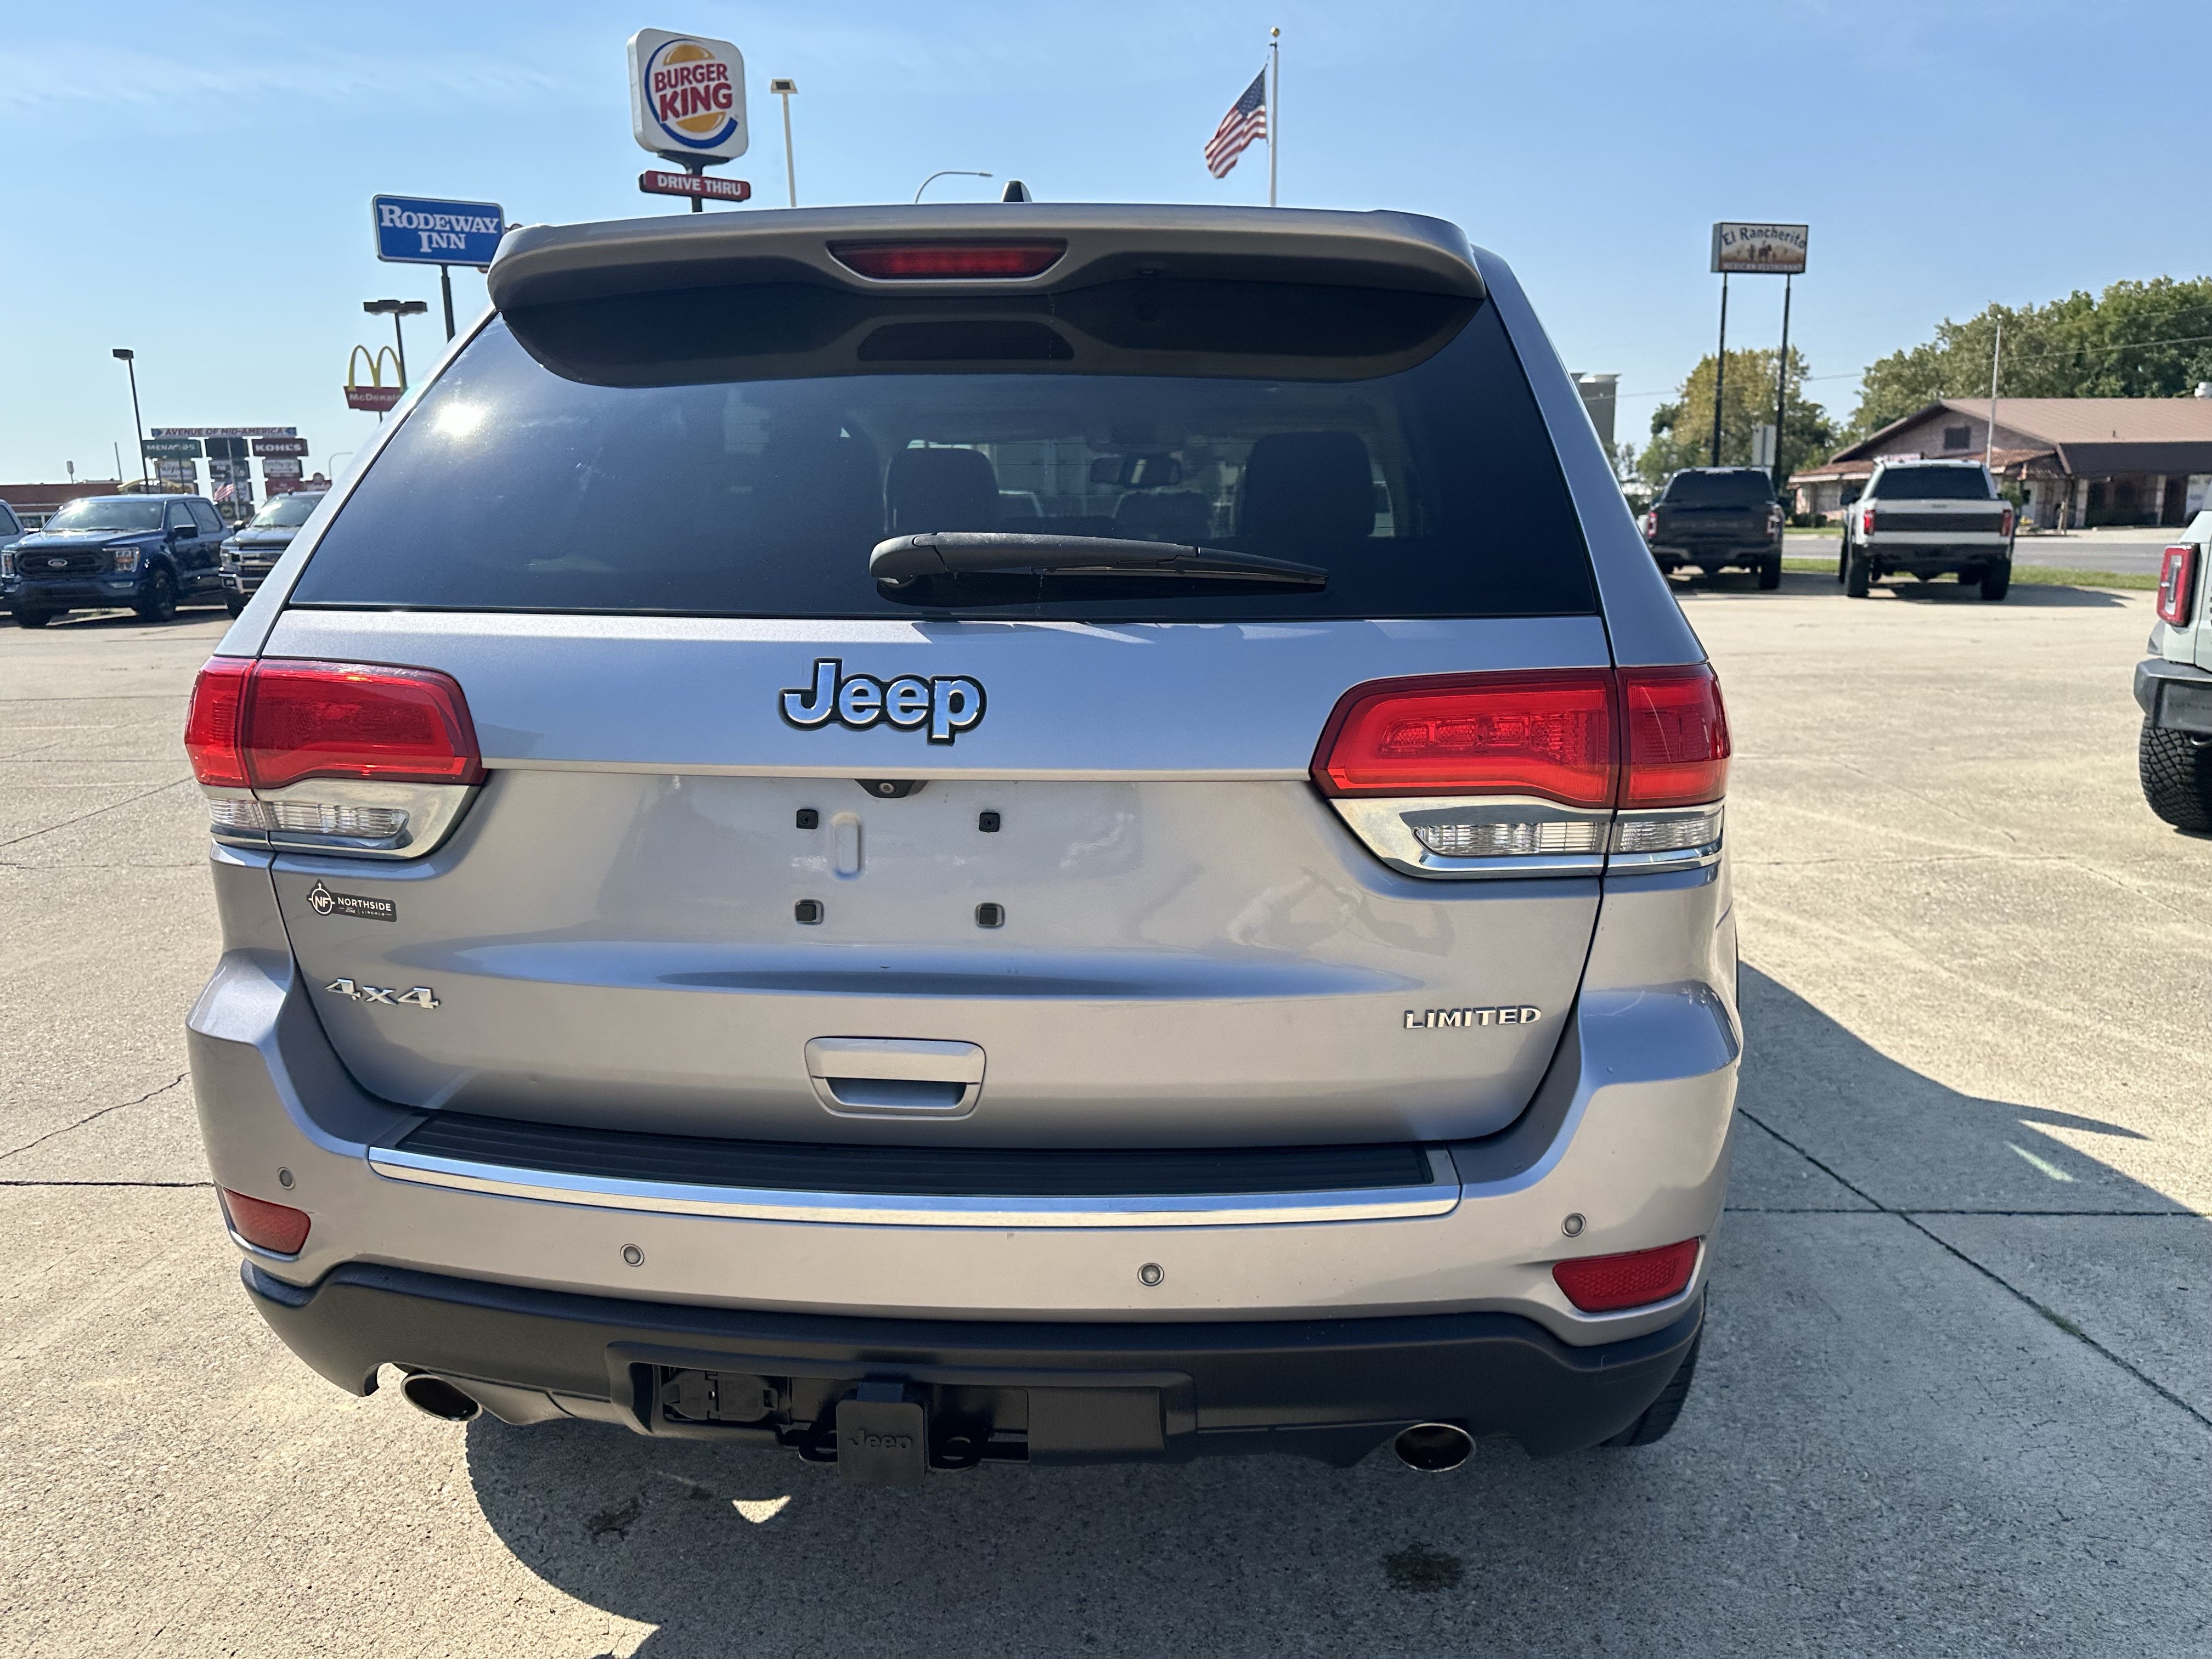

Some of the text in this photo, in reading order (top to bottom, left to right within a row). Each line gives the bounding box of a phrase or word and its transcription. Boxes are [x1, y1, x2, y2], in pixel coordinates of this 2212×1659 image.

[654, 63, 729, 93] BURGER
[659, 82, 732, 122] KING
[657, 175, 741, 196] DRIVE THRU
[379, 204, 499, 234] RODEWAY
[418, 231, 466, 252] INN
[1723, 225, 1806, 249] El Rancherito
[255, 443, 302, 452] KOHL'S
[780, 659, 986, 744] Jeep
[337, 897, 392, 911] NORTHSIDE
[1404, 1005, 1542, 1029] LIMITED
[849, 1427, 913, 1452] Jeep
